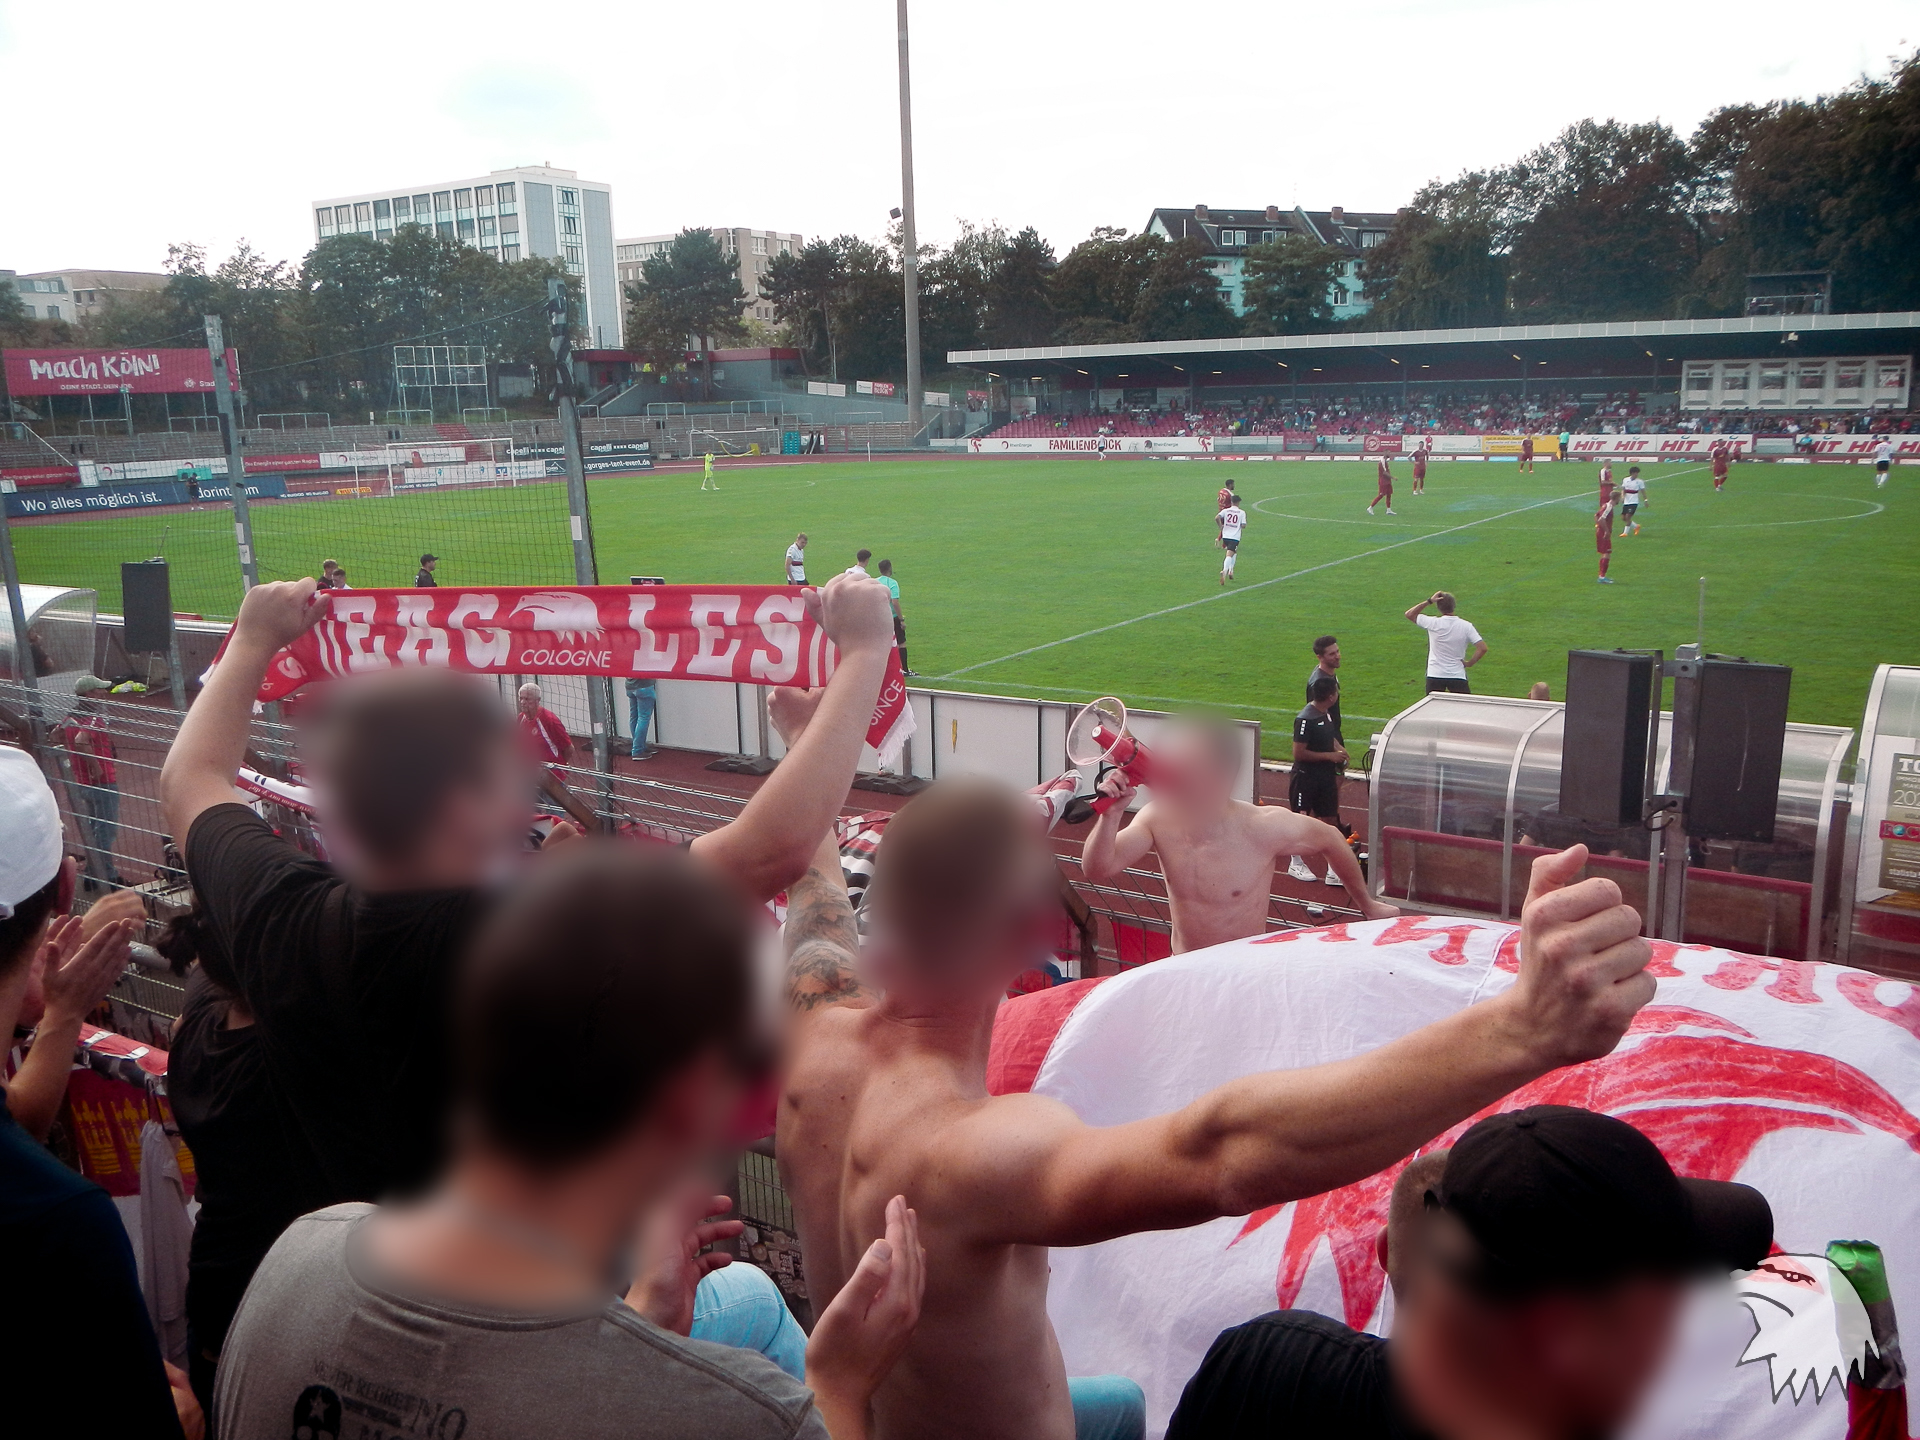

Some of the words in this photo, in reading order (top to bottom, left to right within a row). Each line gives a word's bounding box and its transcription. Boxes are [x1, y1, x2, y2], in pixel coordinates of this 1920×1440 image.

[1049, 440, 1121, 451] FAMILIENBOCK
[1573, 441, 1607, 451] HIT
[1614, 441, 1649, 451] HIT
[1660, 440, 1699, 451] HIT
[21, 499, 46, 511] Wo
[51, 497, 82, 510] alles
[86, 492, 138, 507] möglich
[140, 491, 161, 503] ist.
[1227, 513, 1238, 523] 20
[520, 649, 612, 668] COLOGNE
[870, 679, 904, 726] SINCE
